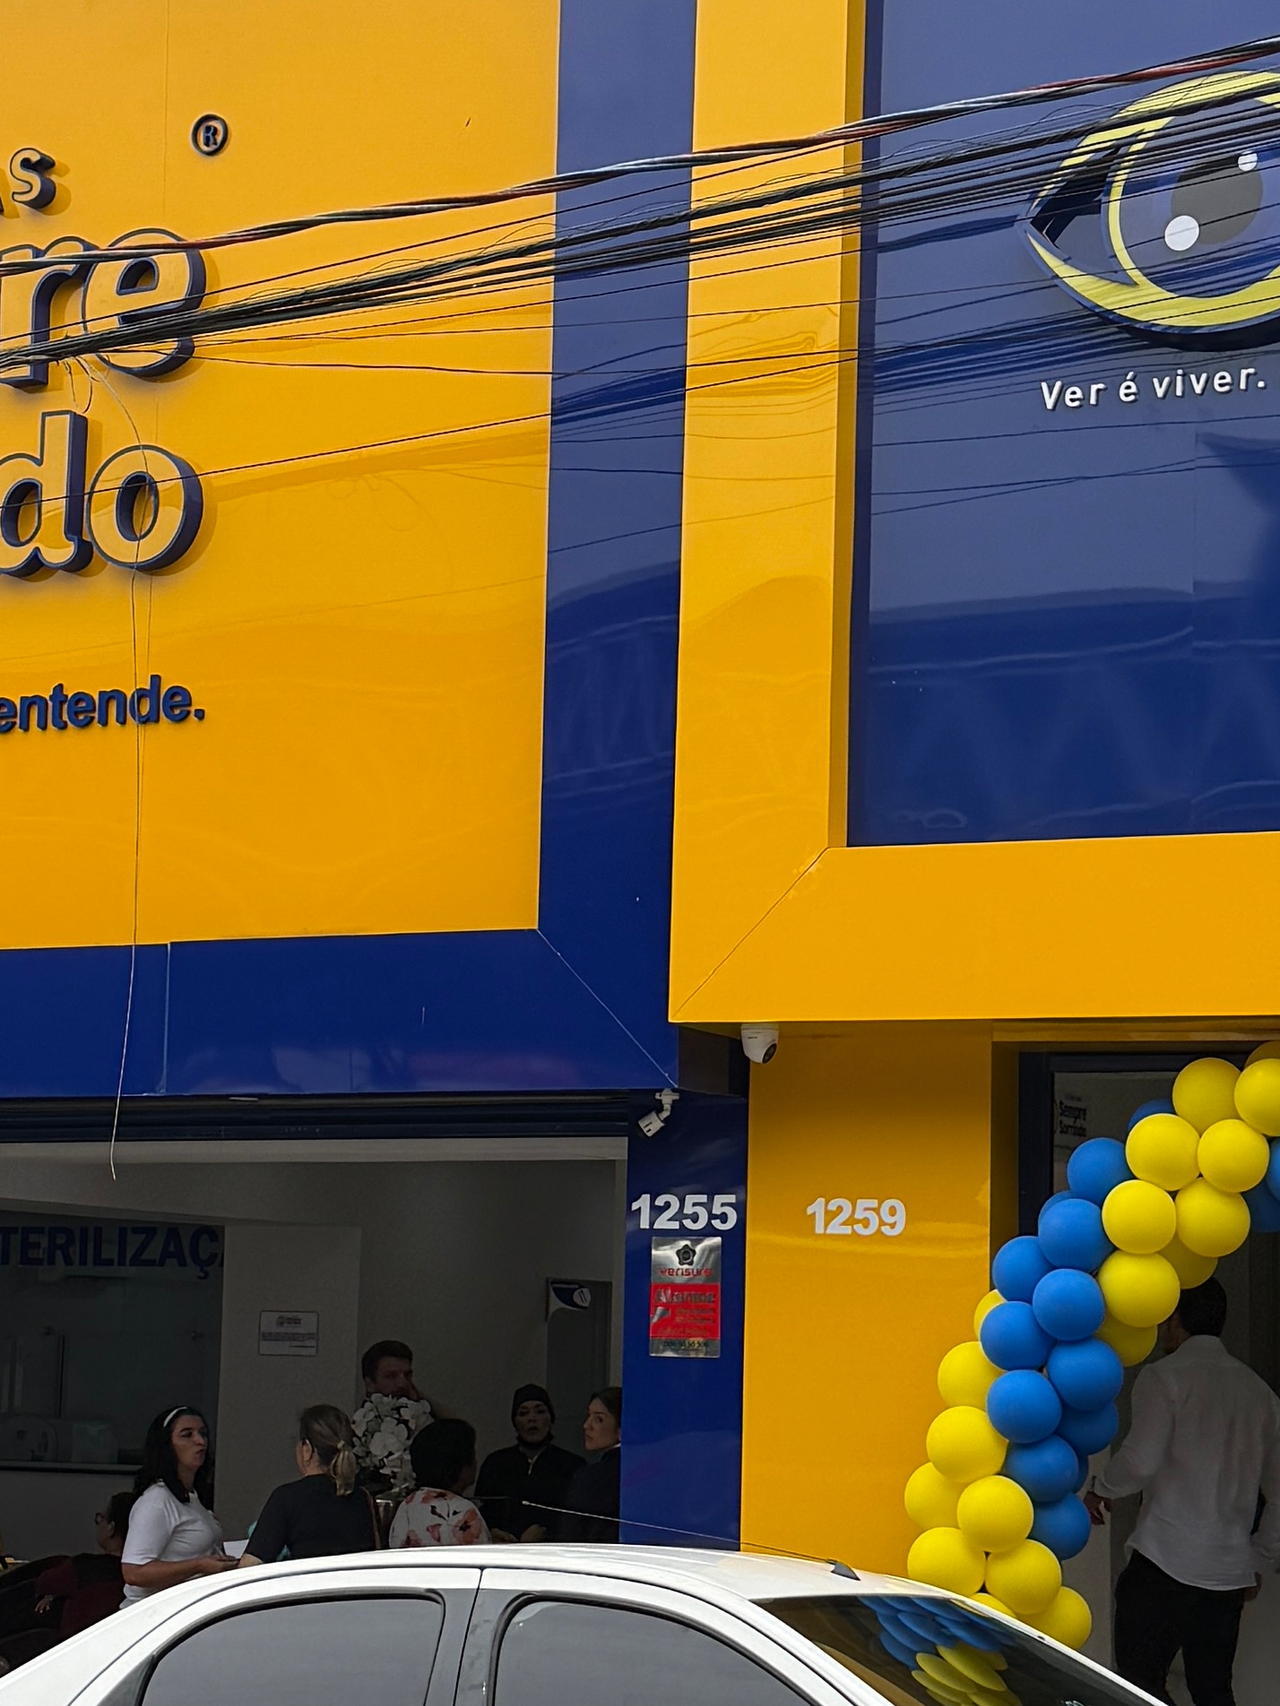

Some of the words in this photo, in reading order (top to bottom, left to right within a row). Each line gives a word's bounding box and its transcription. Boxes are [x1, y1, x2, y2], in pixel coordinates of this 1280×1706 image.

[1040, 380, 1106, 411] Ver
[1119, 371, 1138, 403] é
[1152, 367, 1266, 399] viver.
[630, 1194, 738, 1231] 1255
[806, 1197, 906, 1237] 1259
